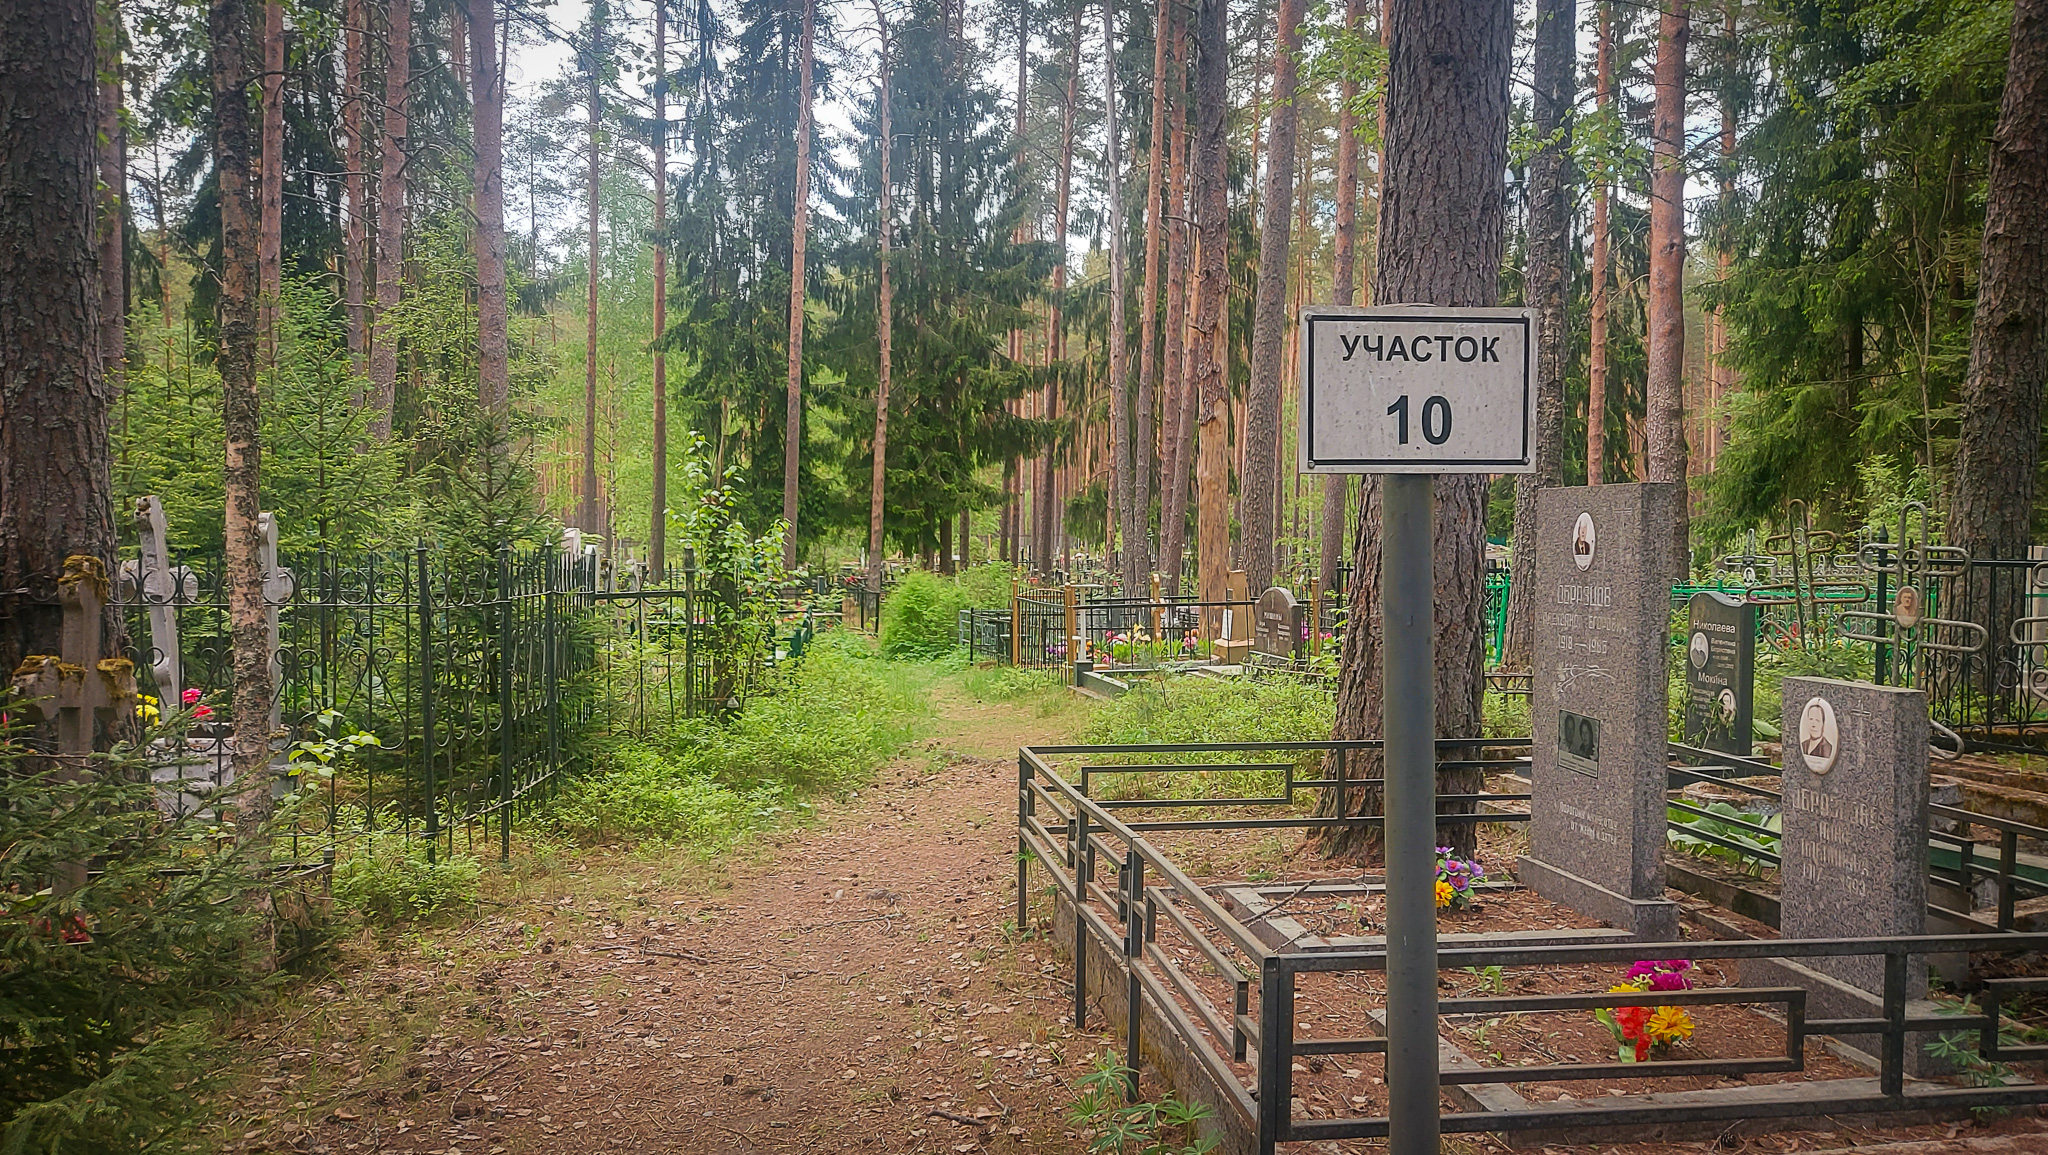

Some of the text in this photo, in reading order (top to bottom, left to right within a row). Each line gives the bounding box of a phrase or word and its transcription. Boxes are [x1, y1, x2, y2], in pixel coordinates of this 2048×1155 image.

[1340, 334, 1500, 363] УЧАСТОК
[1387, 395, 1453, 445] 10
[1557, 584, 1611, 607] ОБРАЗЦОВ
[1693, 619, 1736, 634] Николаева
